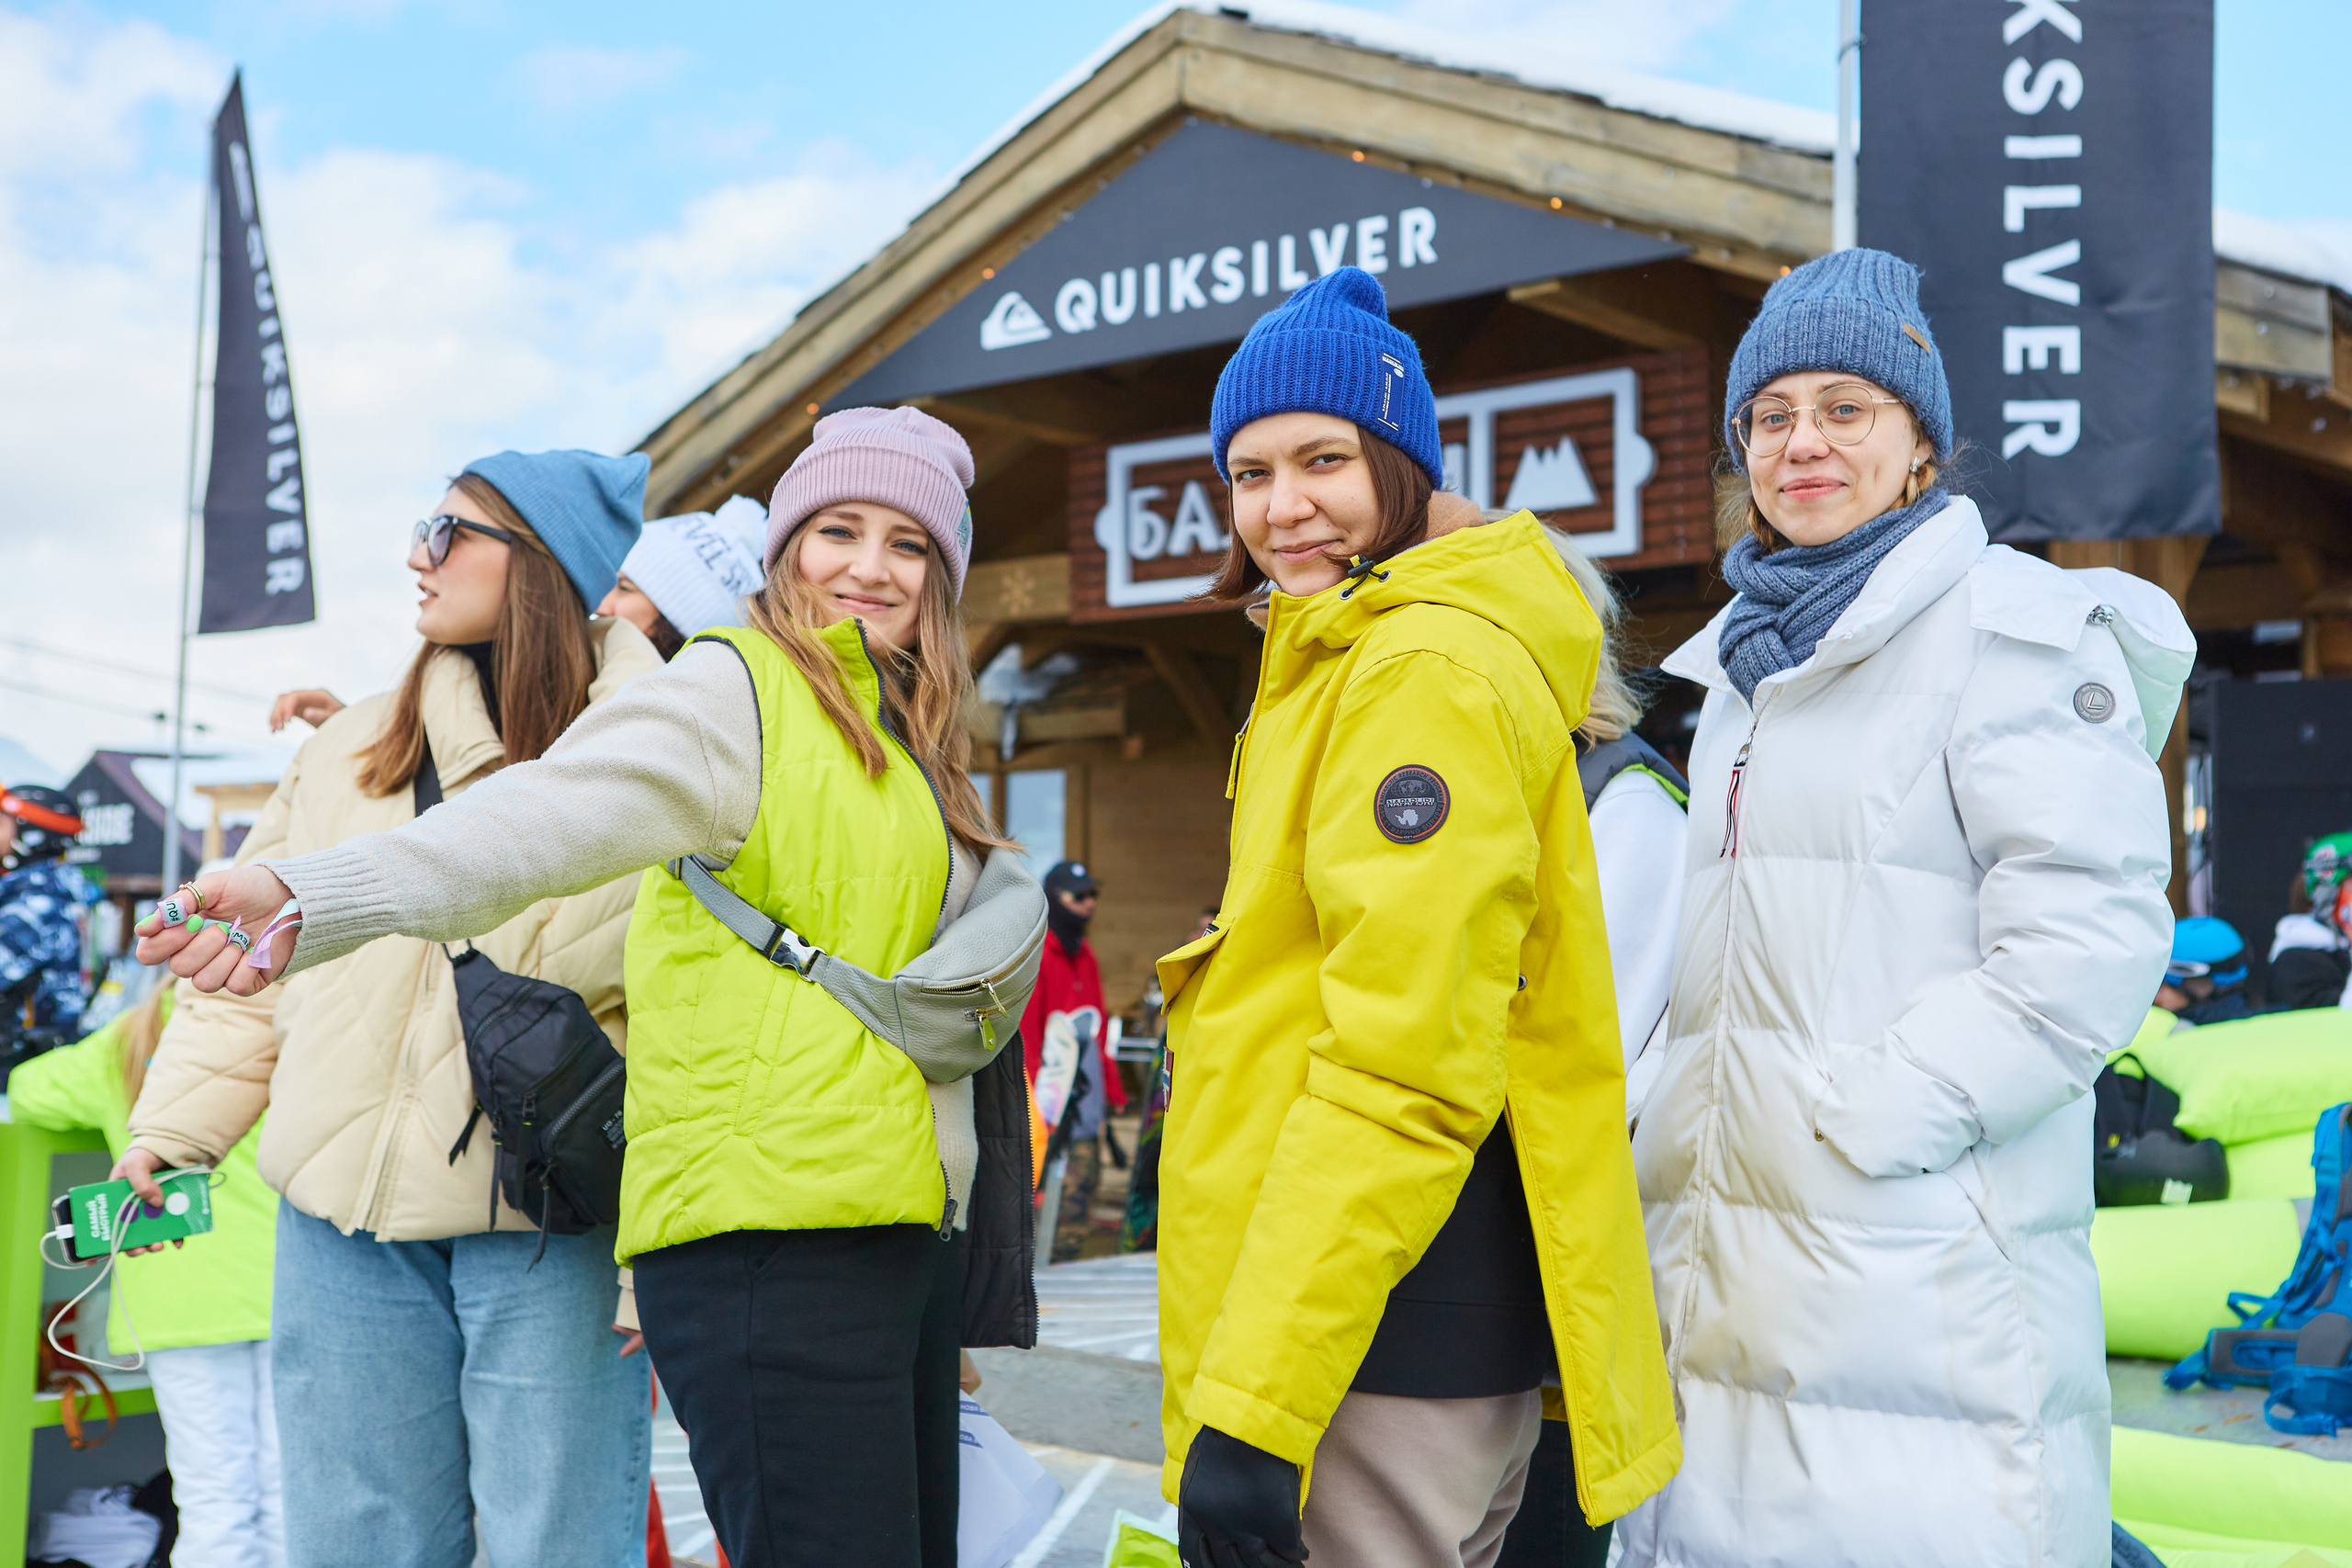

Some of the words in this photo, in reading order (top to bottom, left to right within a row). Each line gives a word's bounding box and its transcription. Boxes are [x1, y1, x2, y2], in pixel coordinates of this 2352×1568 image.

[1054, 207, 1439, 334] QUIKSILVER
[2002, 0, 2085, 460] KSILVER
[1385, 797, 1435, 807] NAPAPIJRI
